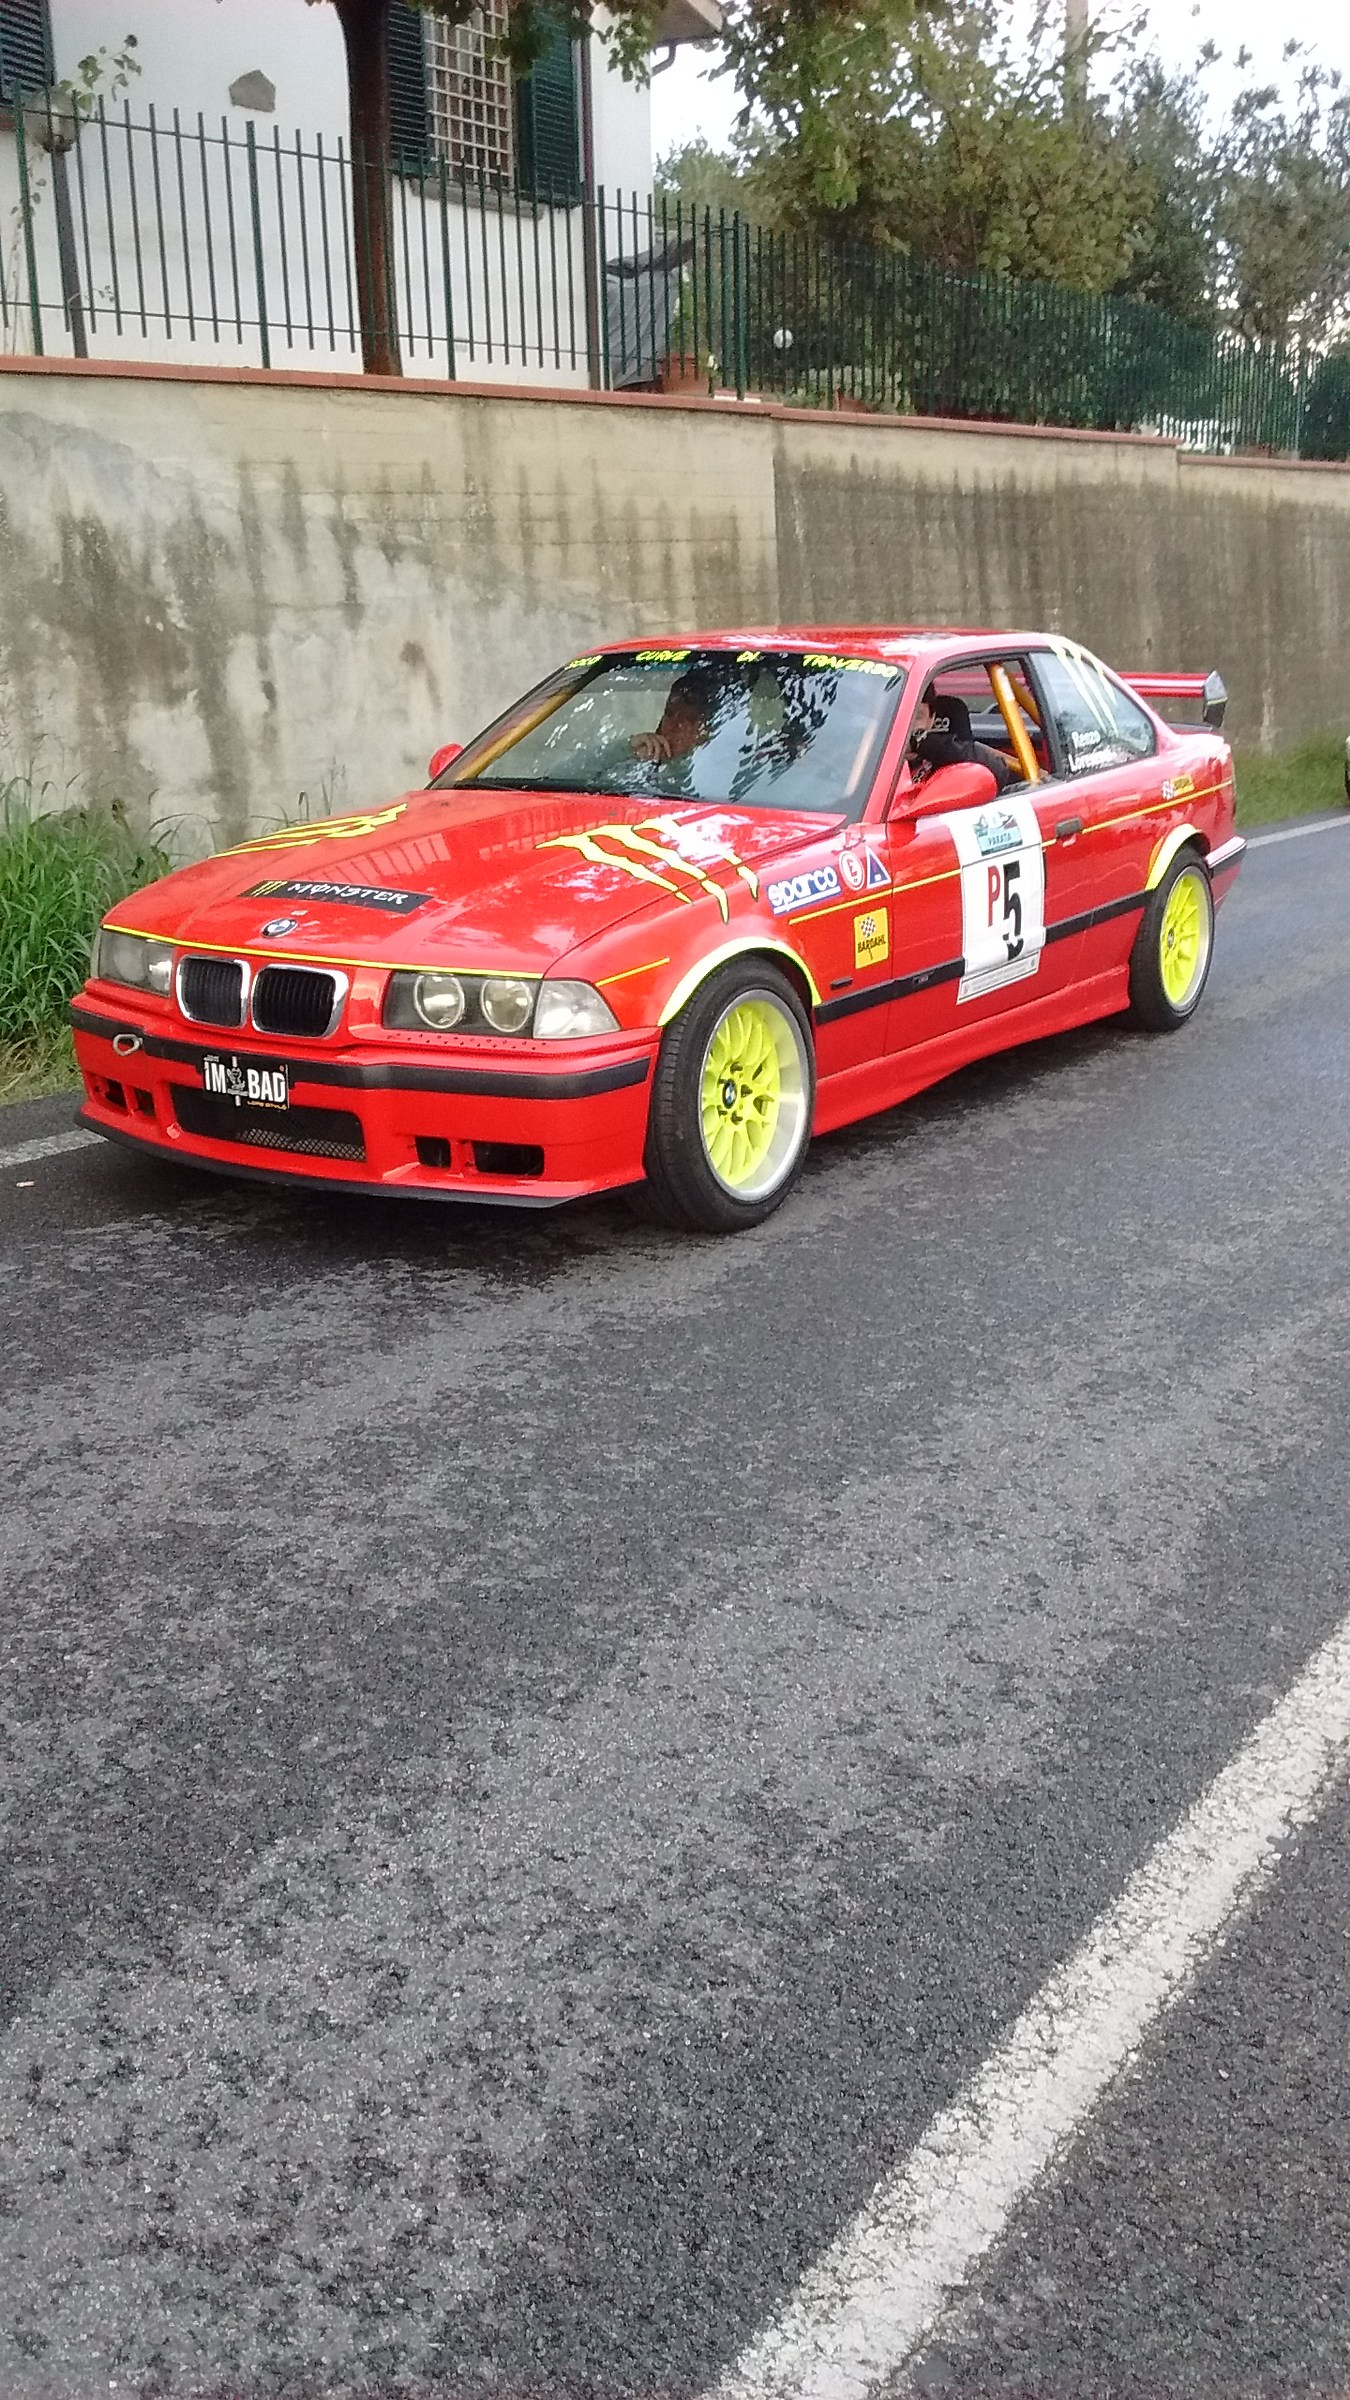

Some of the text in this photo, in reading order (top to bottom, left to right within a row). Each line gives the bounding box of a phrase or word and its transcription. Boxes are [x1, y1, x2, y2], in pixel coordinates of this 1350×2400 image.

[635, 650, 691, 662] CURVE
[737, 651, 760, 662] DI
[768, 866, 839, 911] sparco
[857, 935, 886, 953] BARDAHL
[247, 1069, 286, 1103] BAD
